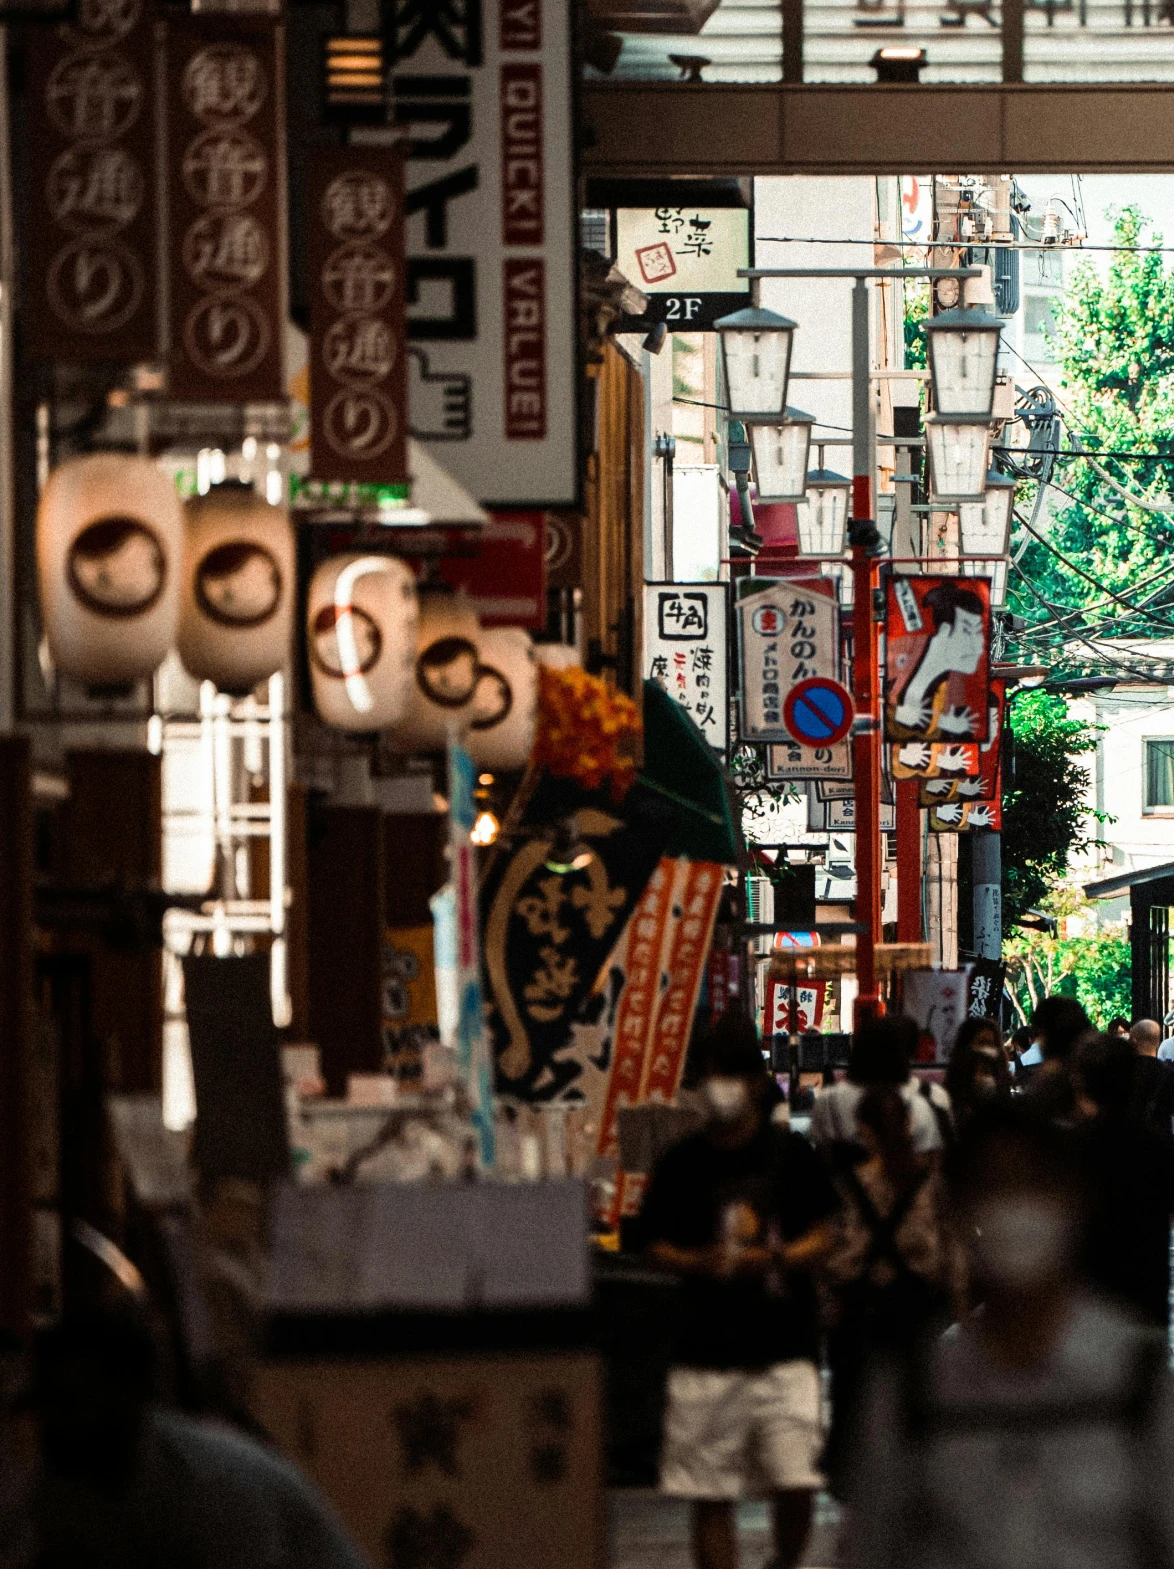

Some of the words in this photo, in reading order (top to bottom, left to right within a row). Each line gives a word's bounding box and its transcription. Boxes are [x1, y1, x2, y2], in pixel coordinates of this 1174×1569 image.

[184, 44, 267, 374] 観音通り
[322, 170, 396, 460] 観音通り
[665, 297, 702, 321] 2F
[665, 601, 704, 630] 牛角
[777, 763, 845, 774] Kannon-dori
